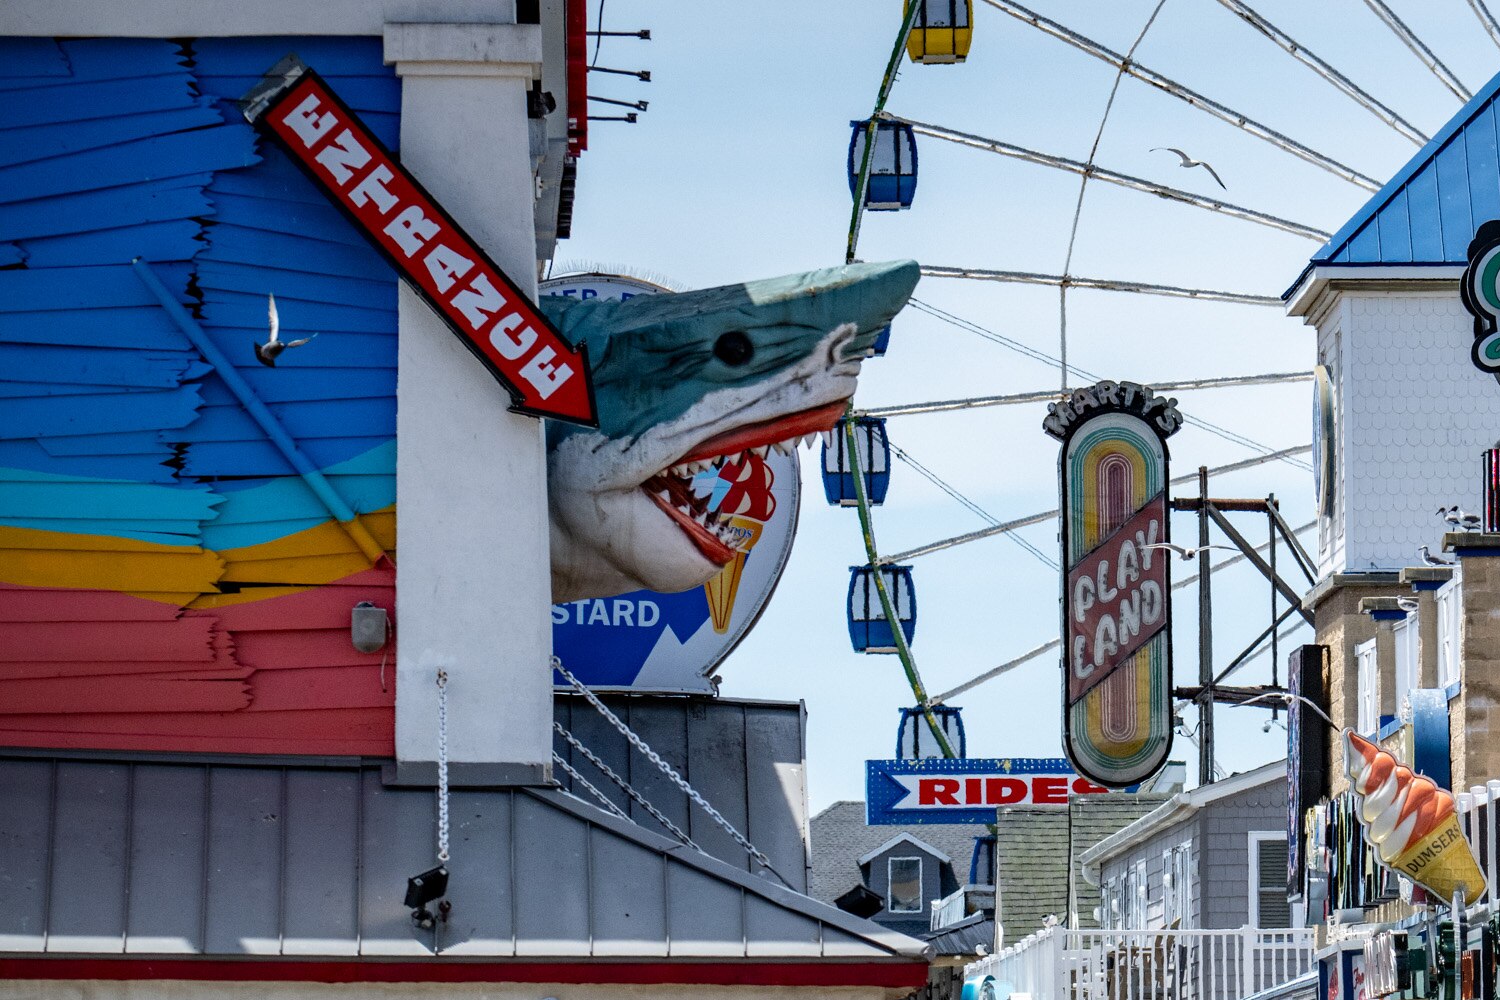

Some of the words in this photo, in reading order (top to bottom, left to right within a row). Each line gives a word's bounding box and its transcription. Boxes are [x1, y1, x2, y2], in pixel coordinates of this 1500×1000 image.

[282, 93, 574, 400] ENTRANCE
[1043, 380, 1183, 433] MARTY'S
[1073, 519, 1159, 623] PLAY
[1074, 580, 1162, 680] LAND
